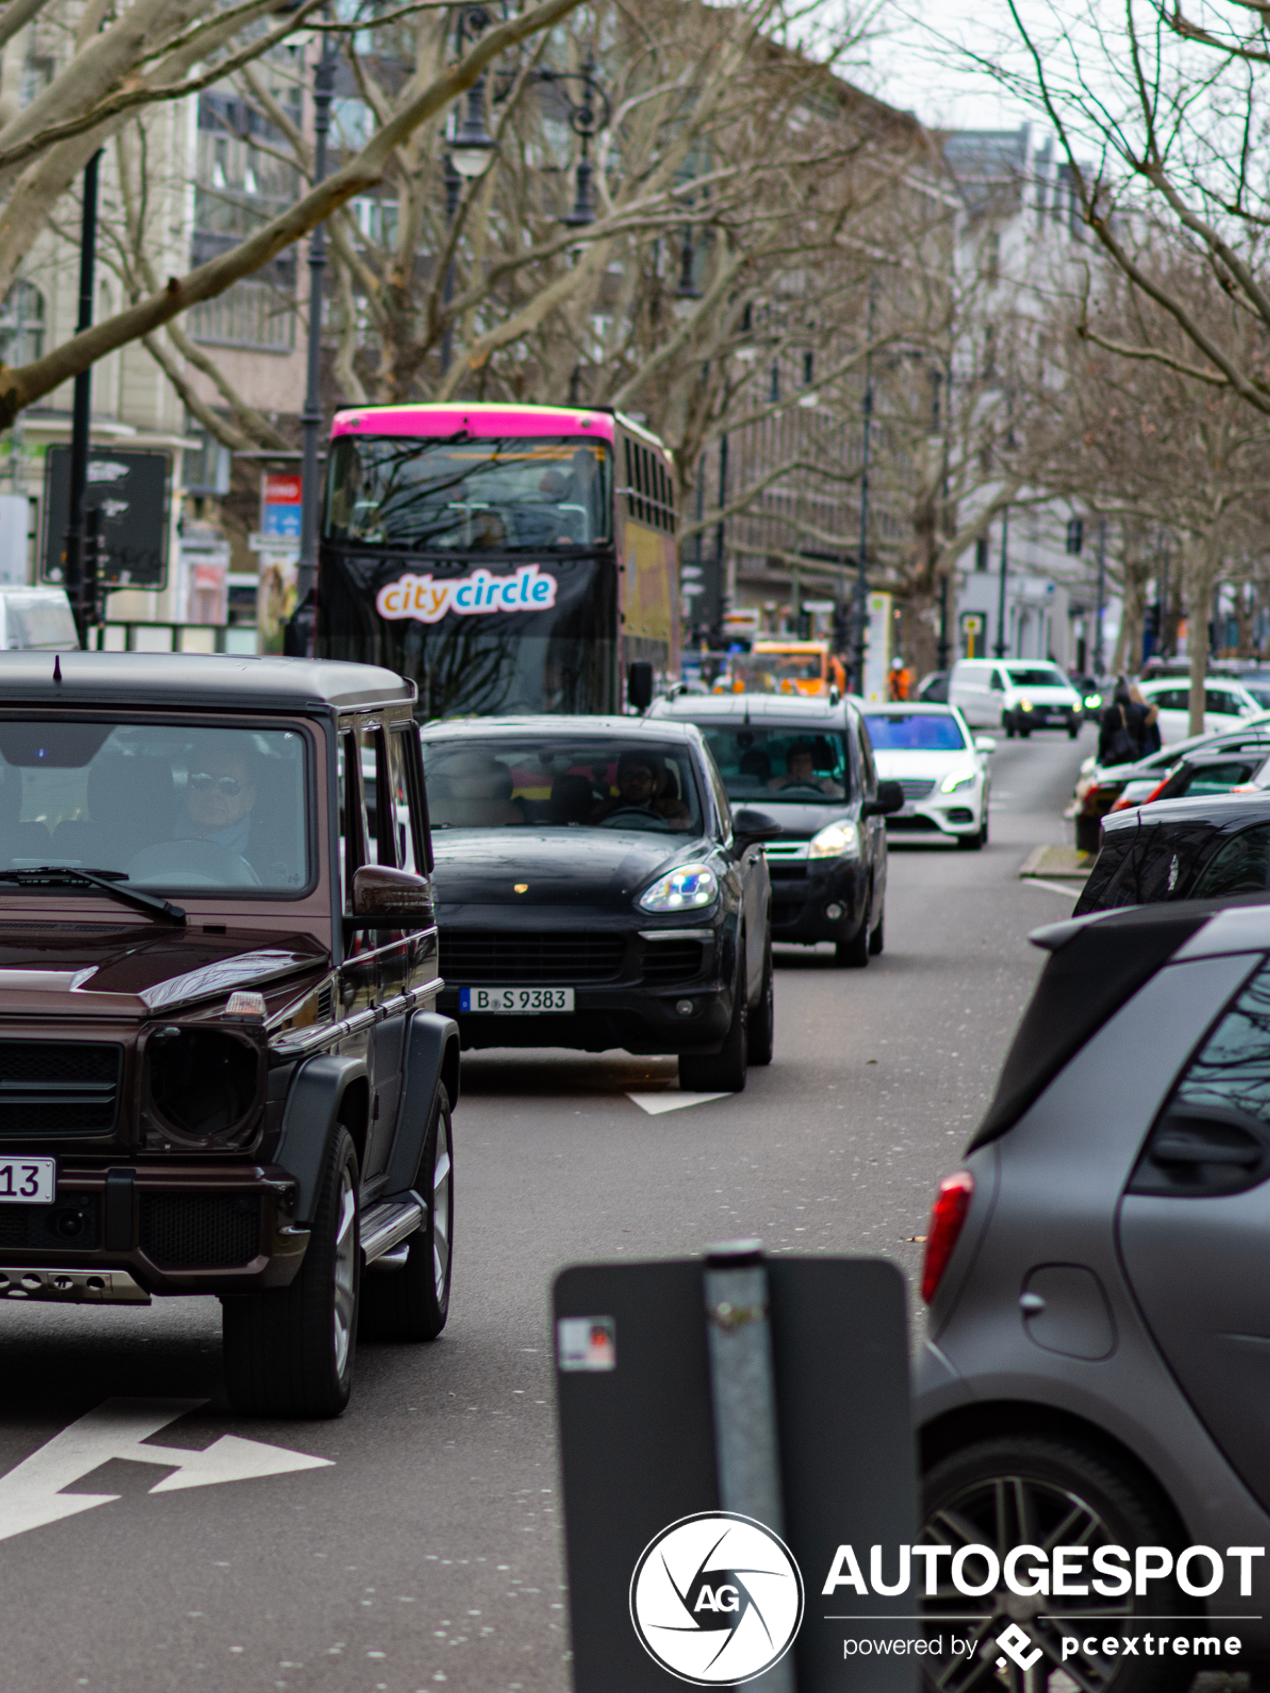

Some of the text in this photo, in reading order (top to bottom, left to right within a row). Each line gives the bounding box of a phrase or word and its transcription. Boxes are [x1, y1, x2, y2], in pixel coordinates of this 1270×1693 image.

[384, 574, 550, 616] city circle
[477, 990, 490, 1009] B
[502, 990, 515, 1009] S
[519, 990, 566, 1009] 9383
